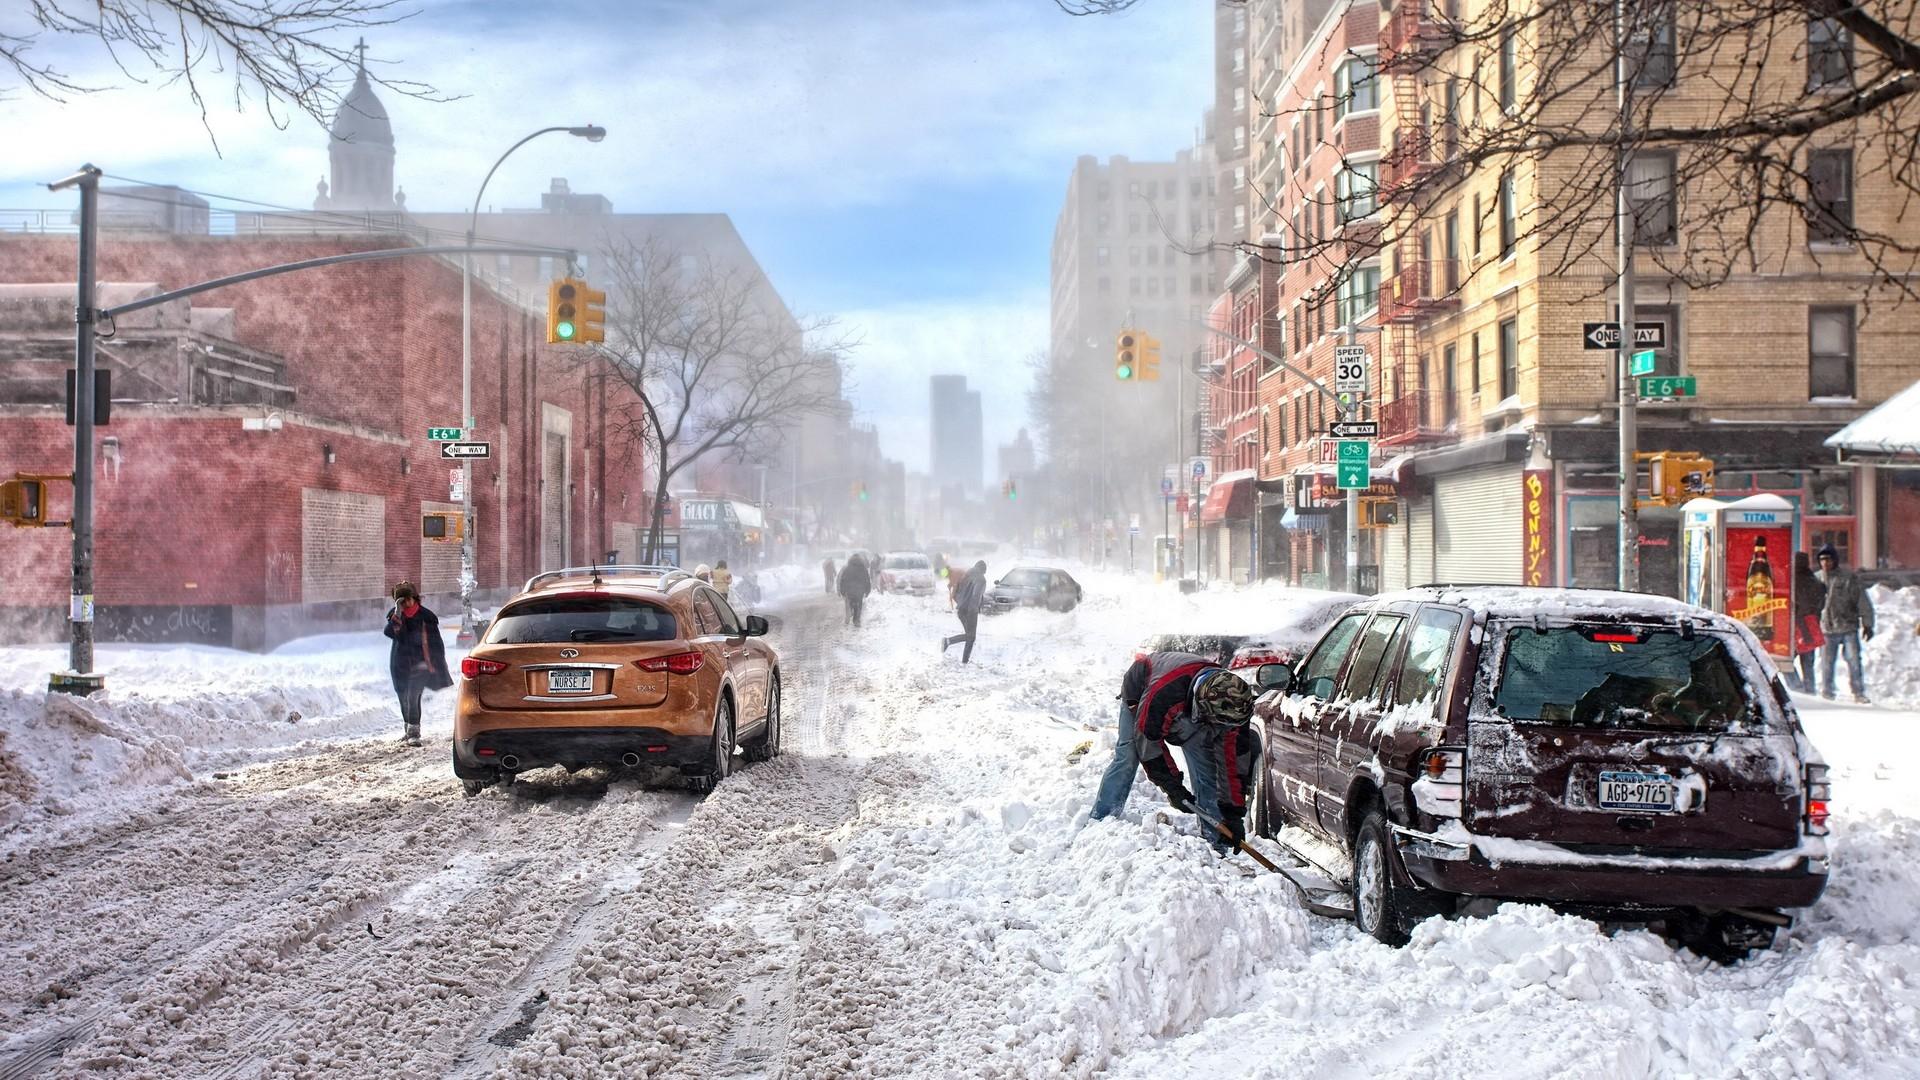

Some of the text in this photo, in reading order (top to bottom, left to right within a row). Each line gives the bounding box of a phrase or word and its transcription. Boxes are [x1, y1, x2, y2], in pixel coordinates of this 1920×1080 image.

[1596, 330, 1618, 342] ONE
[1337, 348, 1364, 356] SPEED
[1340, 356, 1361, 364] LIMIT
[1338, 364, 1363, 379] 30
[1646, 379, 1686, 395] E 6 ST
[432, 429, 439, 439] E
[441, 429, 448, 439] 6
[1336, 426, 1351, 434] ONE
[448, 446, 484, 454] ONE WAY
[1743, 512, 1776, 523] TITAN
[554, 676, 587, 688] NURSE P
